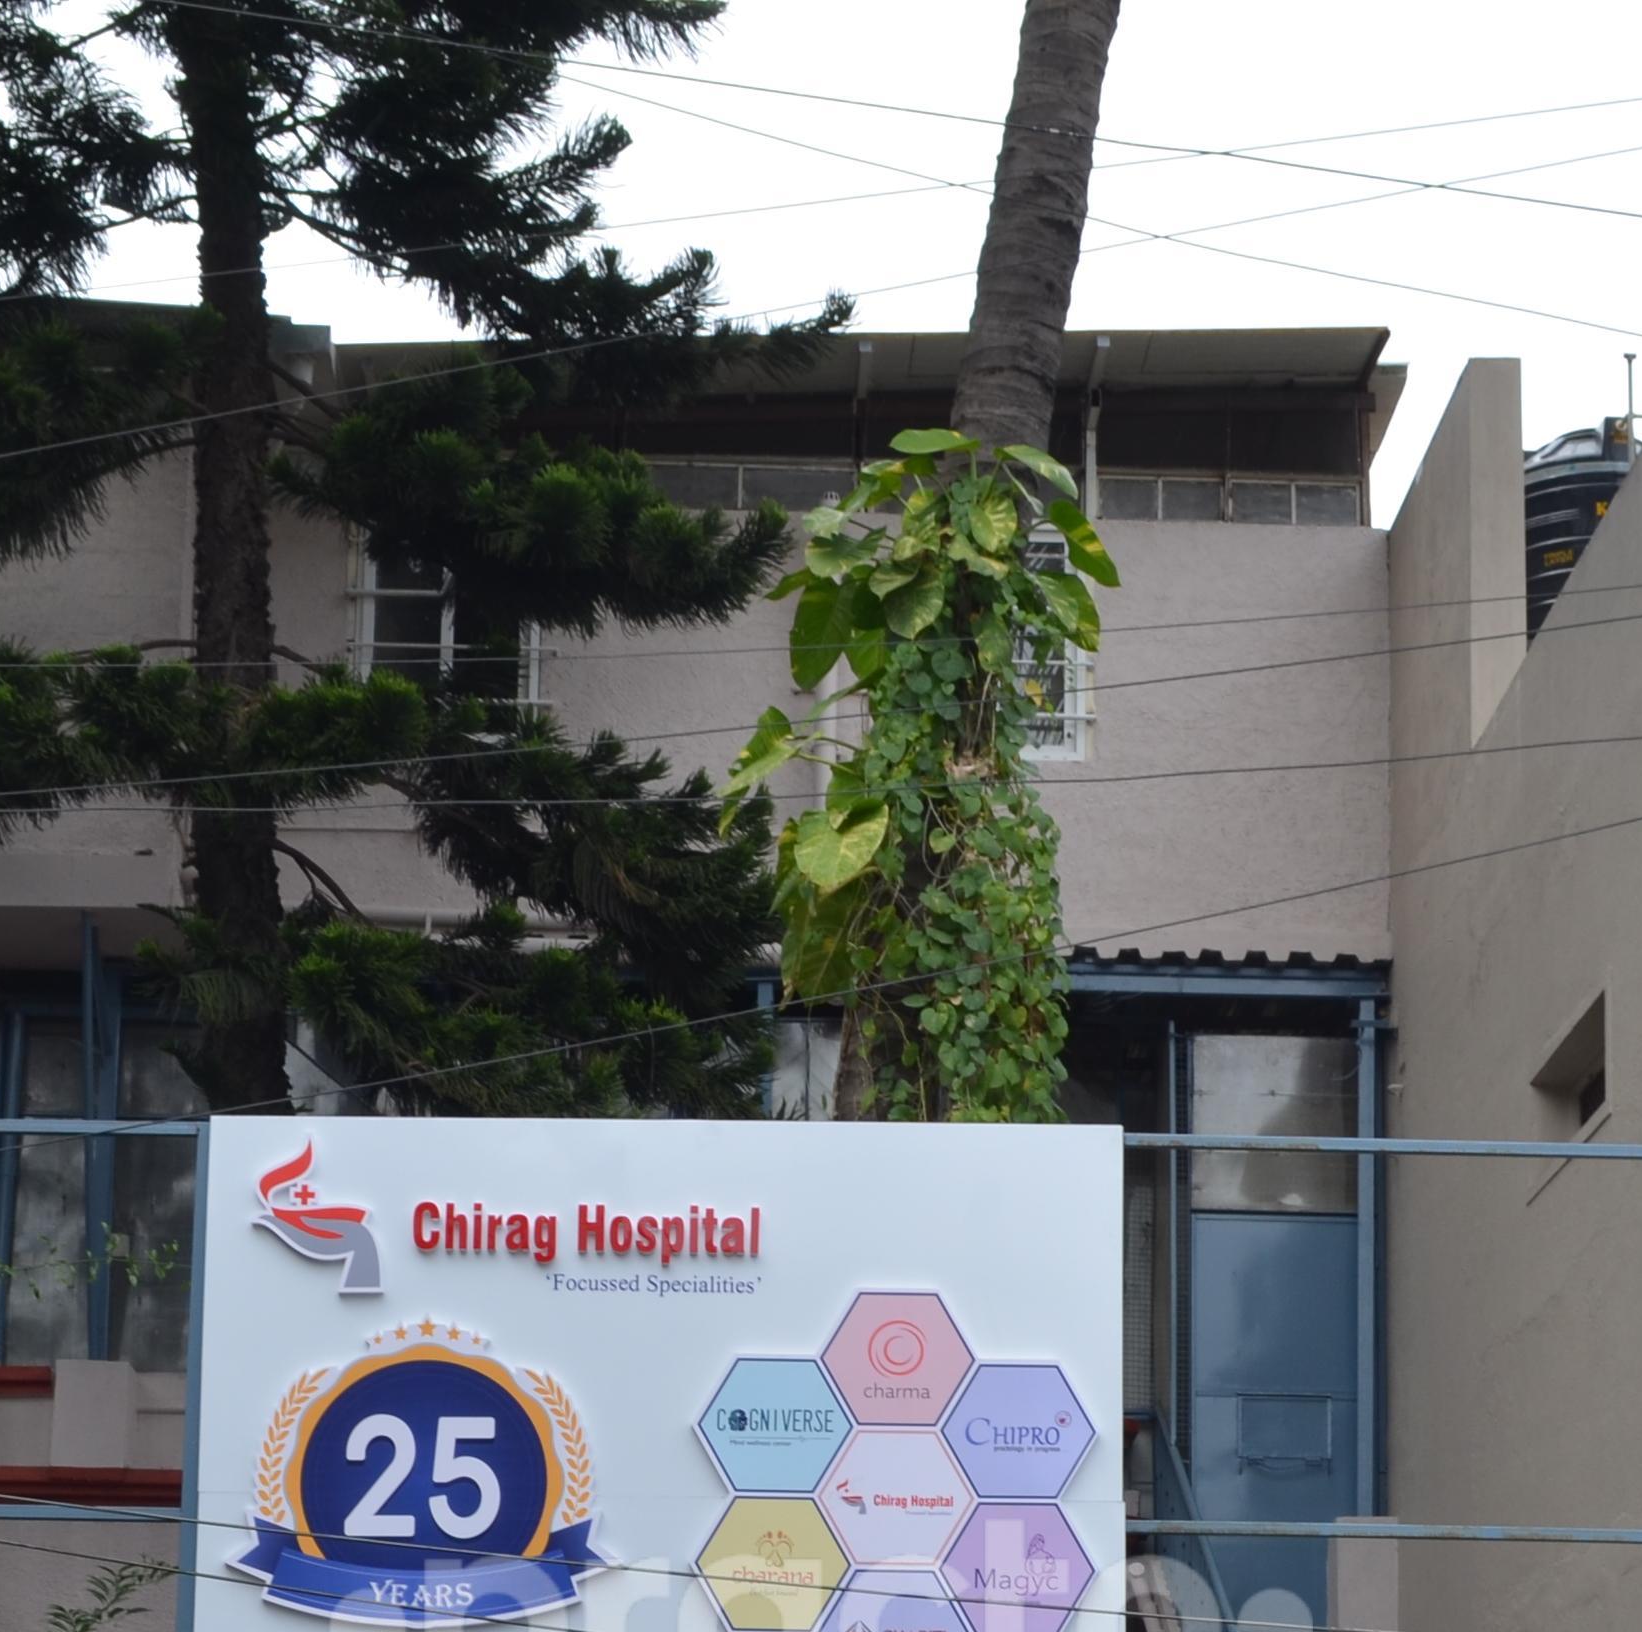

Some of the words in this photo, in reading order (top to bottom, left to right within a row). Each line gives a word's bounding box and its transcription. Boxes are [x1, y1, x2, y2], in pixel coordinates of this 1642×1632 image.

[413, 1201, 558, 1263] Chirag
[578, 1205, 762, 1266] Hospital
[863, 1383, 931, 1400] charma
[343, 1411, 501, 1541] 25
[873, 1493, 908, 1510] Chirag
[910, 1494, 954, 1510] Hospital
[369, 1577, 474, 1612] YEARS
[974, 1567, 1059, 1596] Magyc
